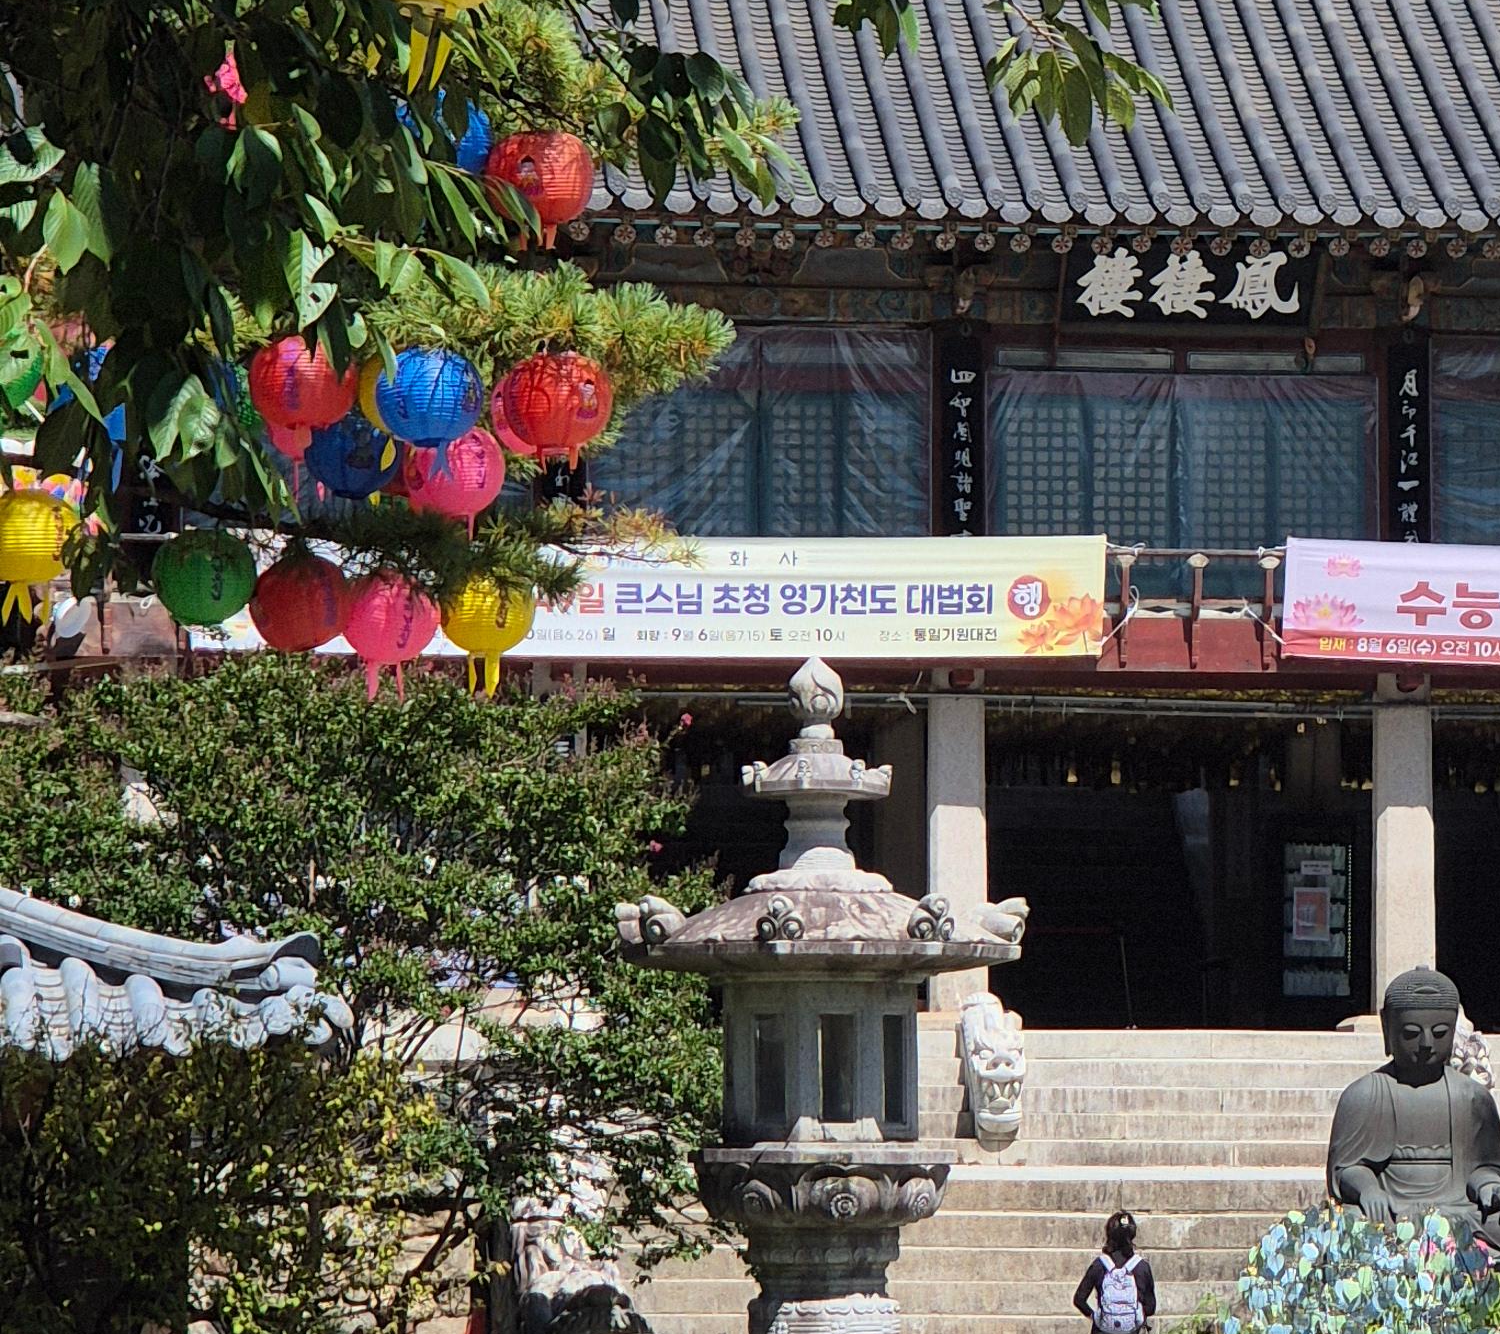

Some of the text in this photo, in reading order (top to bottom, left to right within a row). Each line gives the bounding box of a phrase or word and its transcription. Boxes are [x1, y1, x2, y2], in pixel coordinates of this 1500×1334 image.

[614, 582, 703, 615] 큰스님
[712, 582, 770, 615] 초청
[779, 582, 898, 615] 영가천도
[906, 583, 993, 615] 대법회
[1012, 581, 1042, 616] 행
[671, 628, 694, 642] 9월
[769, 628, 783, 641] 토
[788, 629, 811, 642] 오전
[815, 628, 845, 642] 10시
[914, 627, 998, 642] 통일기원대전
[1356, 637, 1383, 653] 8월
[1385, 638, 1437, 656] 6일(수)
[1440, 640, 1470, 657] 오전
